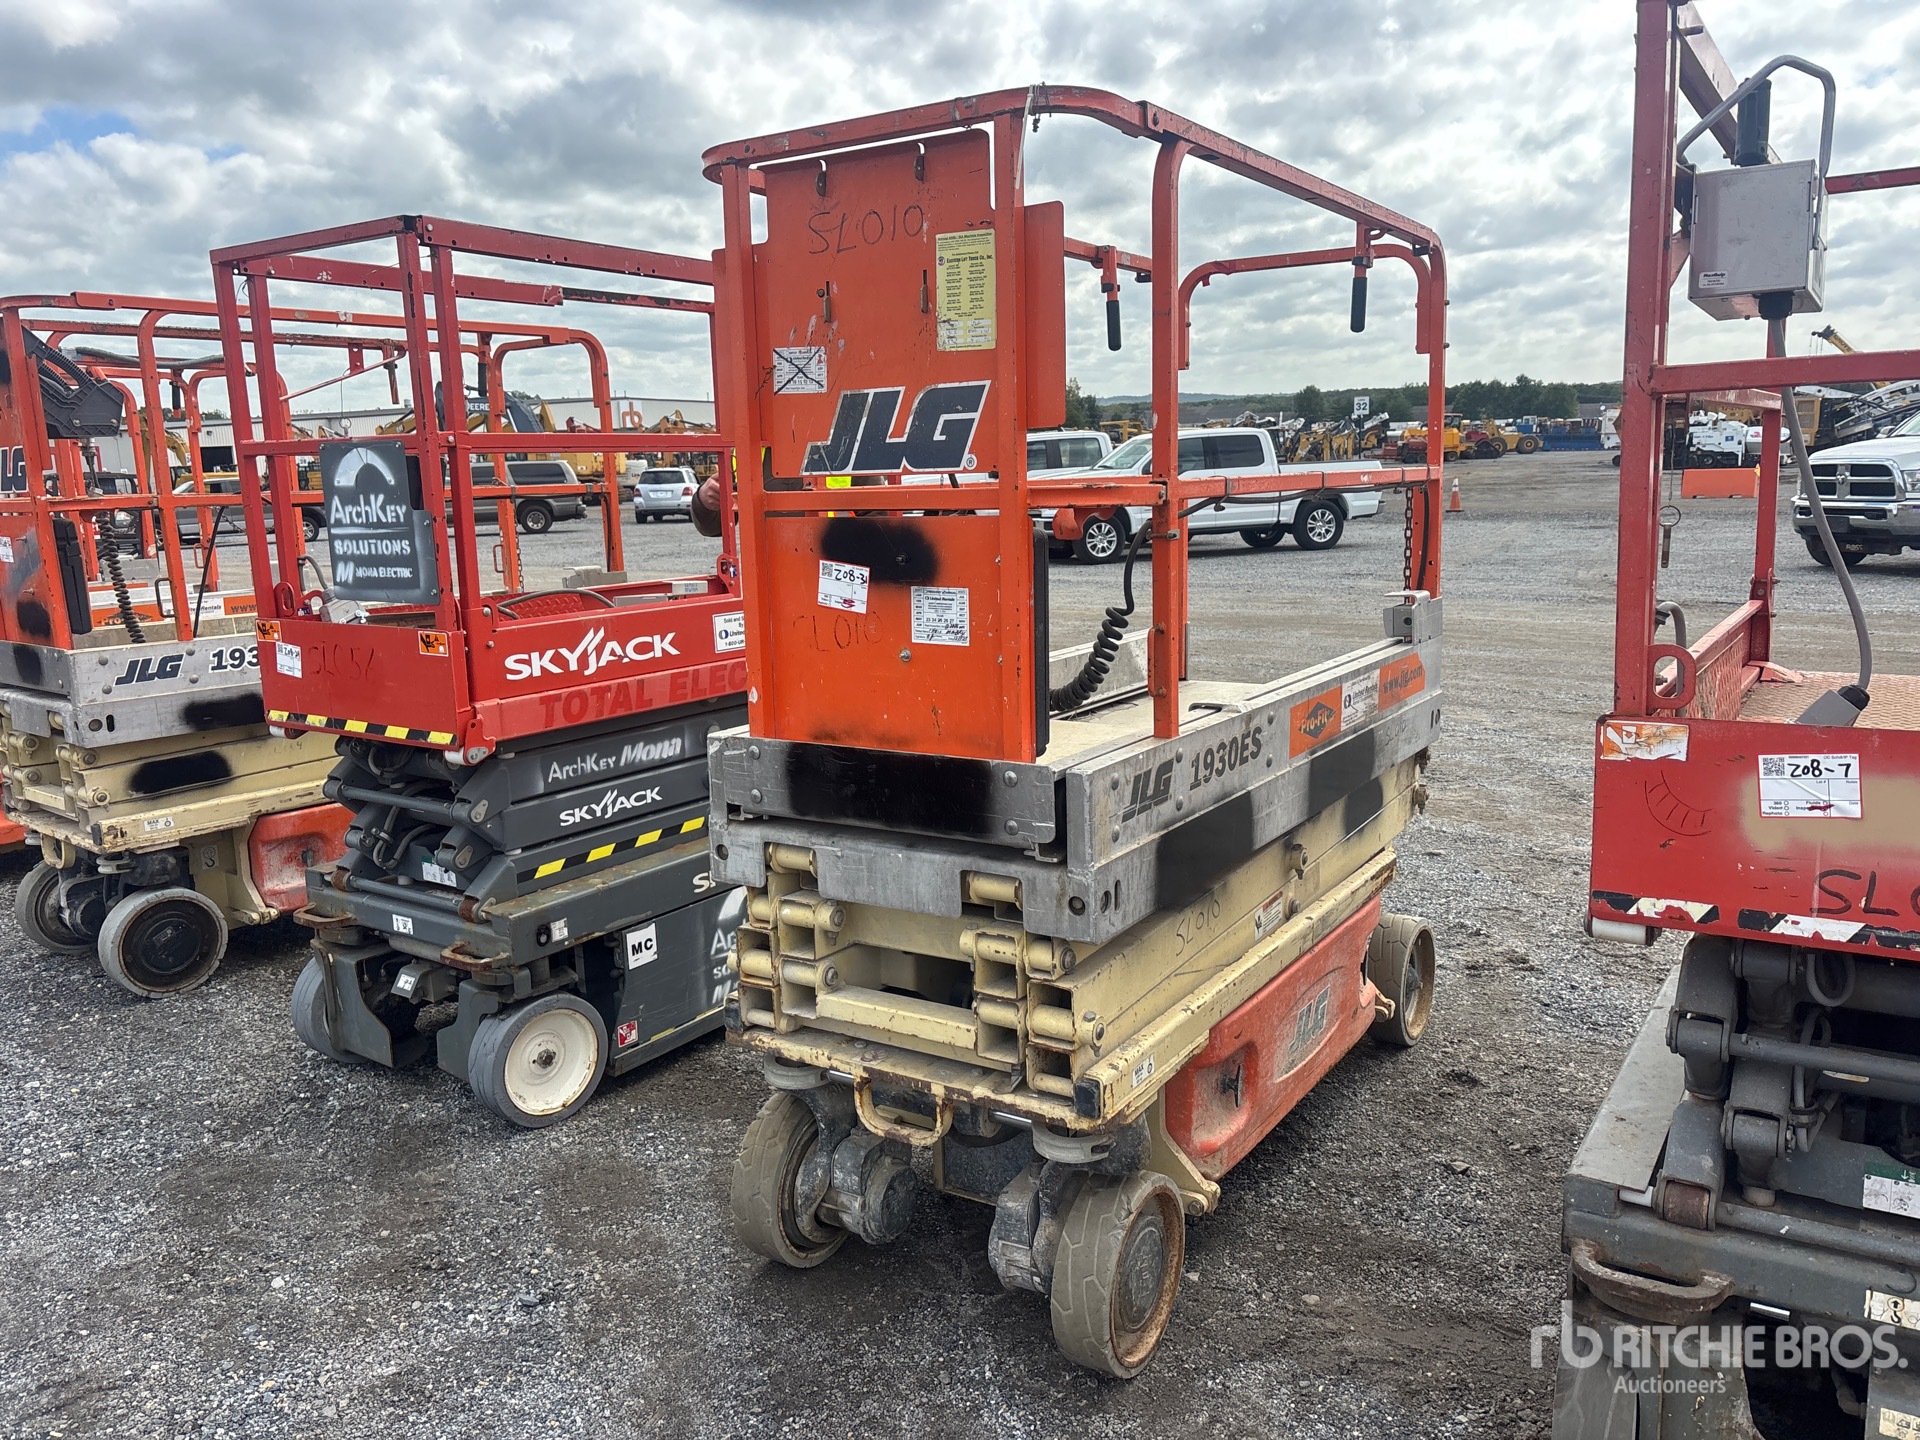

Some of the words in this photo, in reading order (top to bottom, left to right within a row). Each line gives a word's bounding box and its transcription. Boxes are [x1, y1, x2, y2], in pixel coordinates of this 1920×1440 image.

[469, 402, 490, 411] EERE
[1356, 402, 1368, 411] 32
[802, 380, 992, 475] JLG
[333, 538, 412, 556] SOLUTIONS
[378, 566, 414, 579] ELECTRIC
[504, 626, 681, 681] SKYJACK
[114, 654, 186, 687] JLG
[540, 678, 654, 728] TOTAL
[620, 738, 682, 767] Mona
[1121, 758, 1175, 824] JLG
[1190, 726, 1262, 791] 1930ES
[560, 786, 663, 826] SKYJACK
[631, 938, 654, 956] MC
[1288, 984, 1332, 1055] JLG
